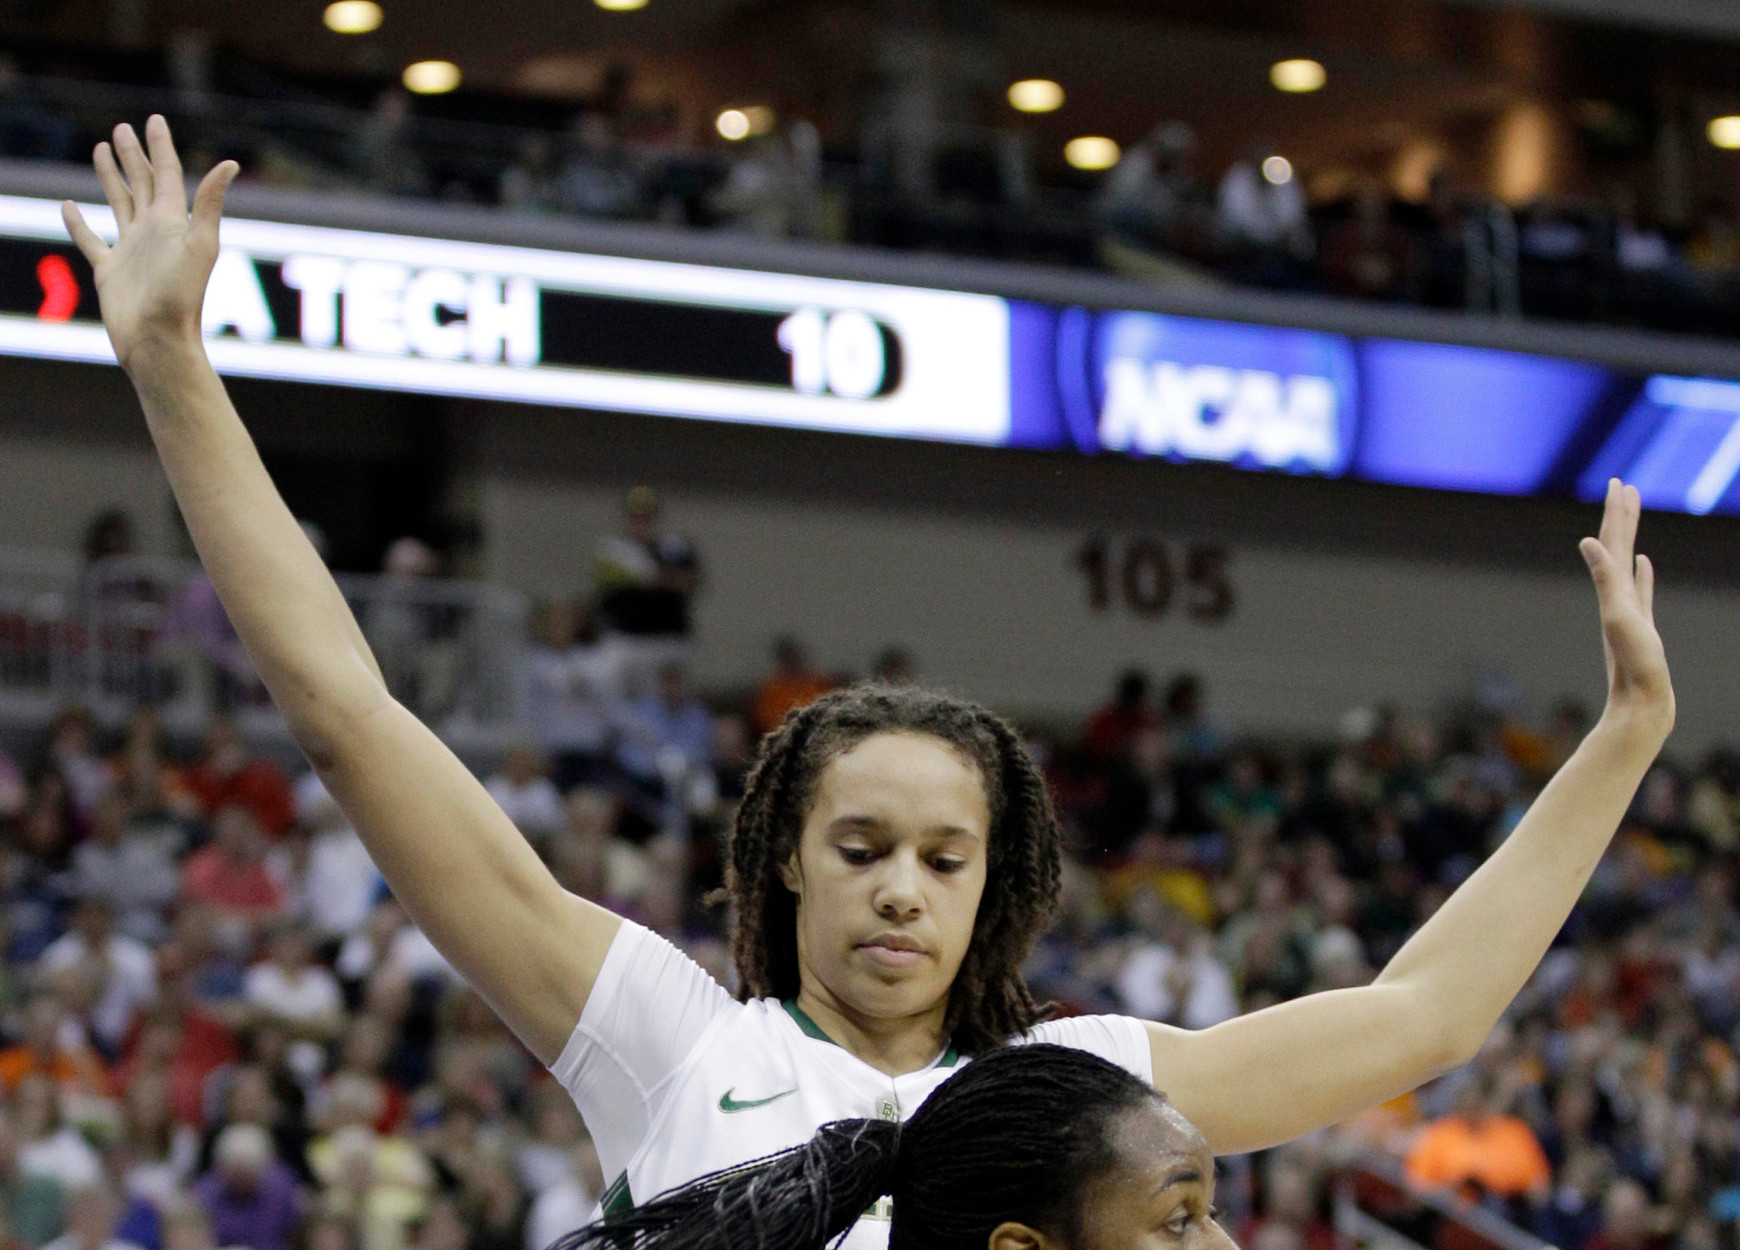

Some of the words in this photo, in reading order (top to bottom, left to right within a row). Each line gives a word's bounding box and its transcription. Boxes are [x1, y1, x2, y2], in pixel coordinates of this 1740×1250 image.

[280, 252, 542, 368] TECH
[777, 305, 886, 398] 10
[1098, 357, 1340, 477] NCAA
[1073, 539, 1235, 622] 105
